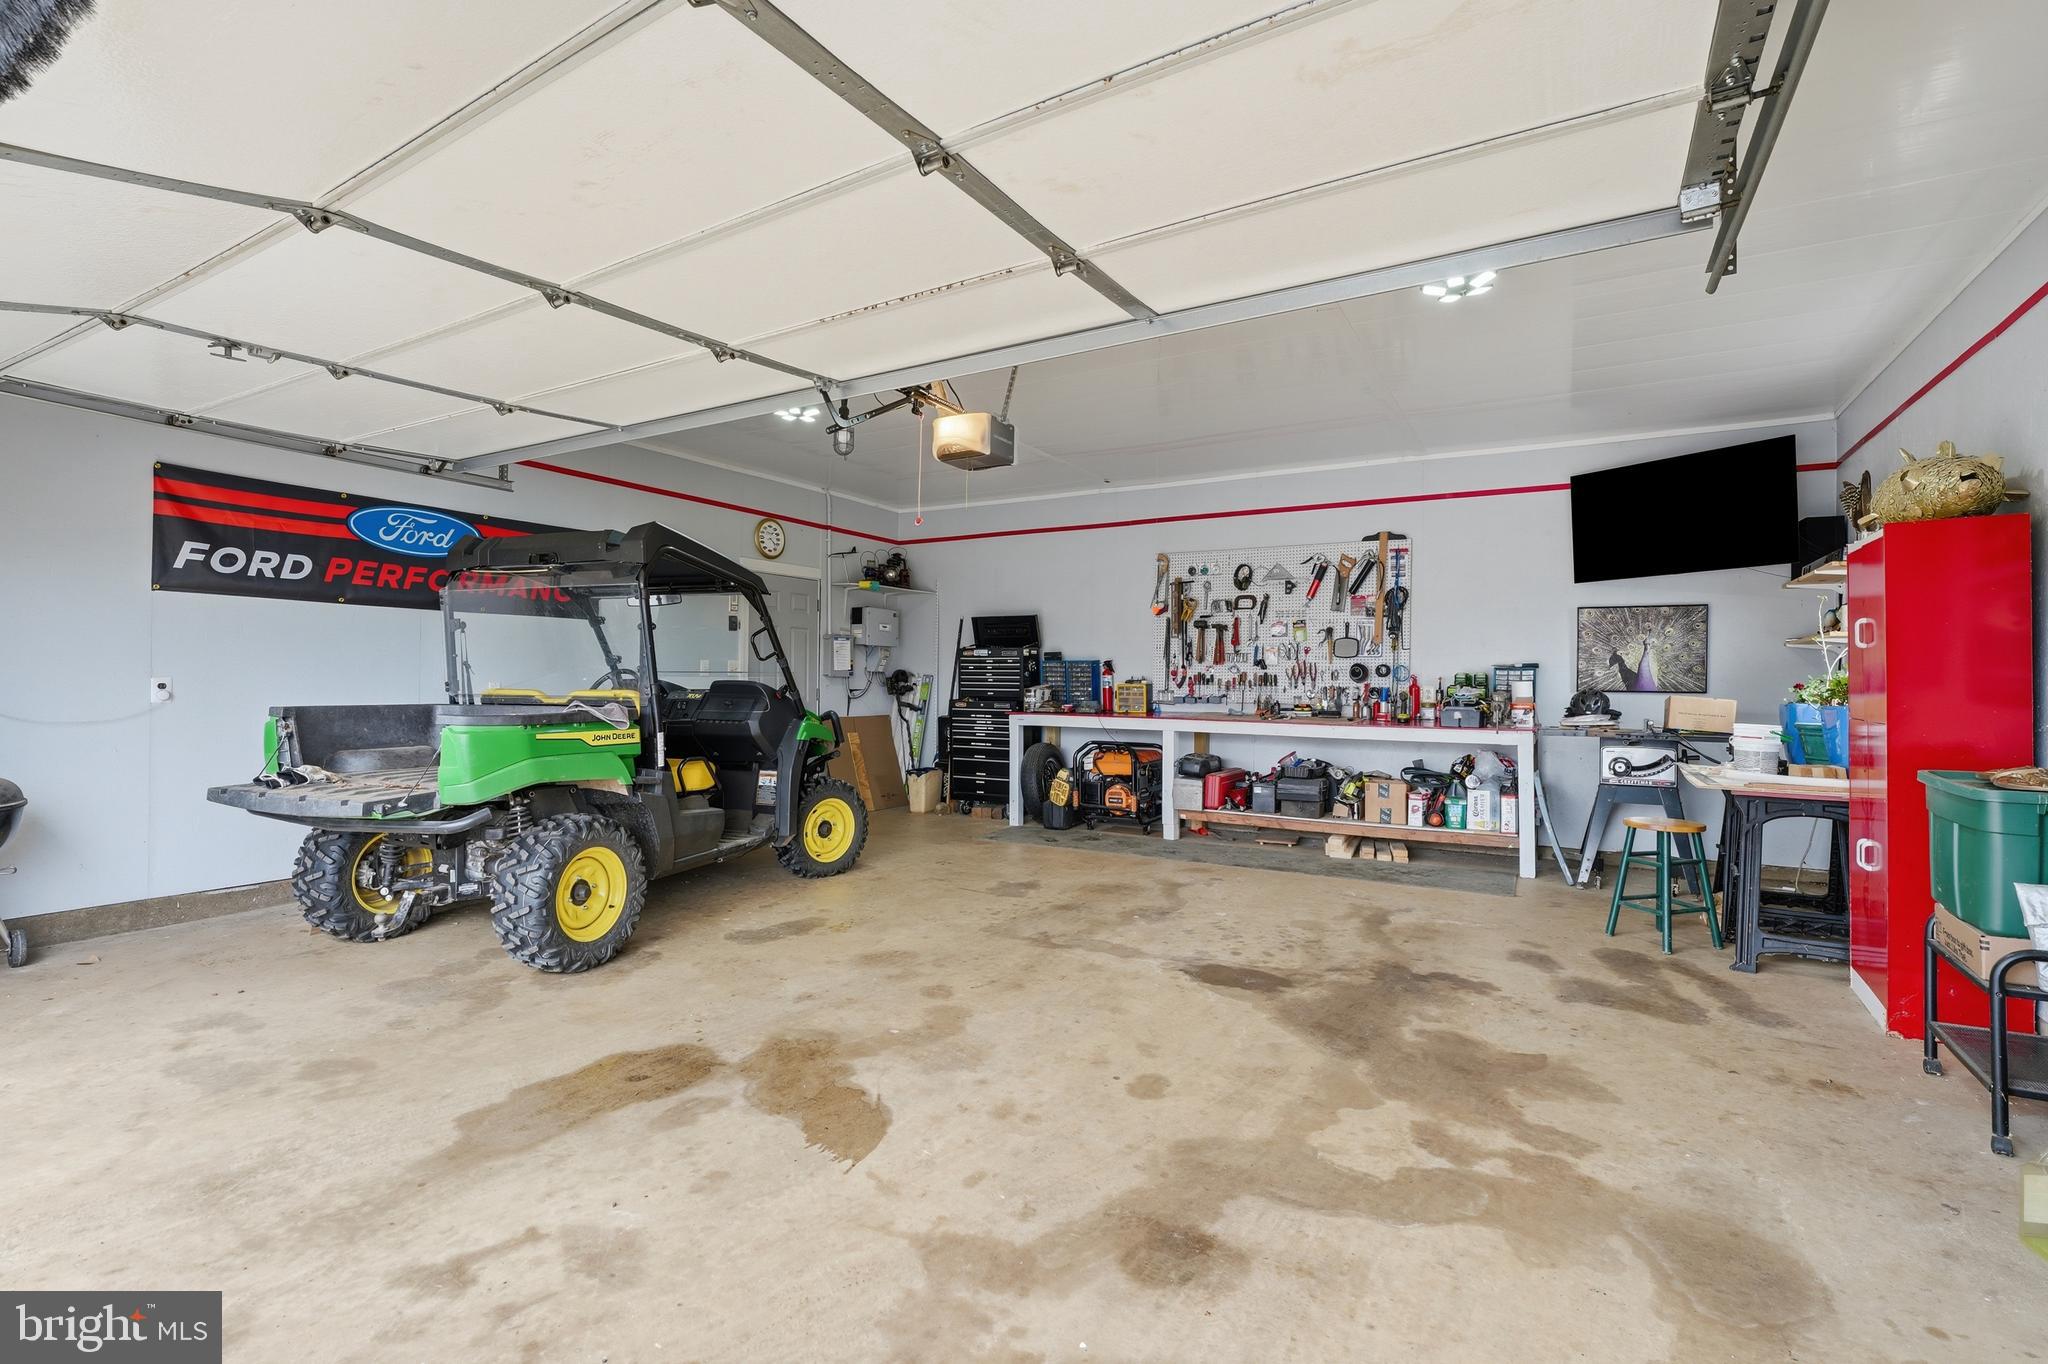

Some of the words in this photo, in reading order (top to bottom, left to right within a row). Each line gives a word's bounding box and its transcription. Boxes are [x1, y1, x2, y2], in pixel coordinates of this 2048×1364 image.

[379, 513, 456, 548] Ford
[173, 541, 313, 580] FORD
[324, 557, 573, 602] PERFORMANC
[592, 734, 611, 742] JOHN
